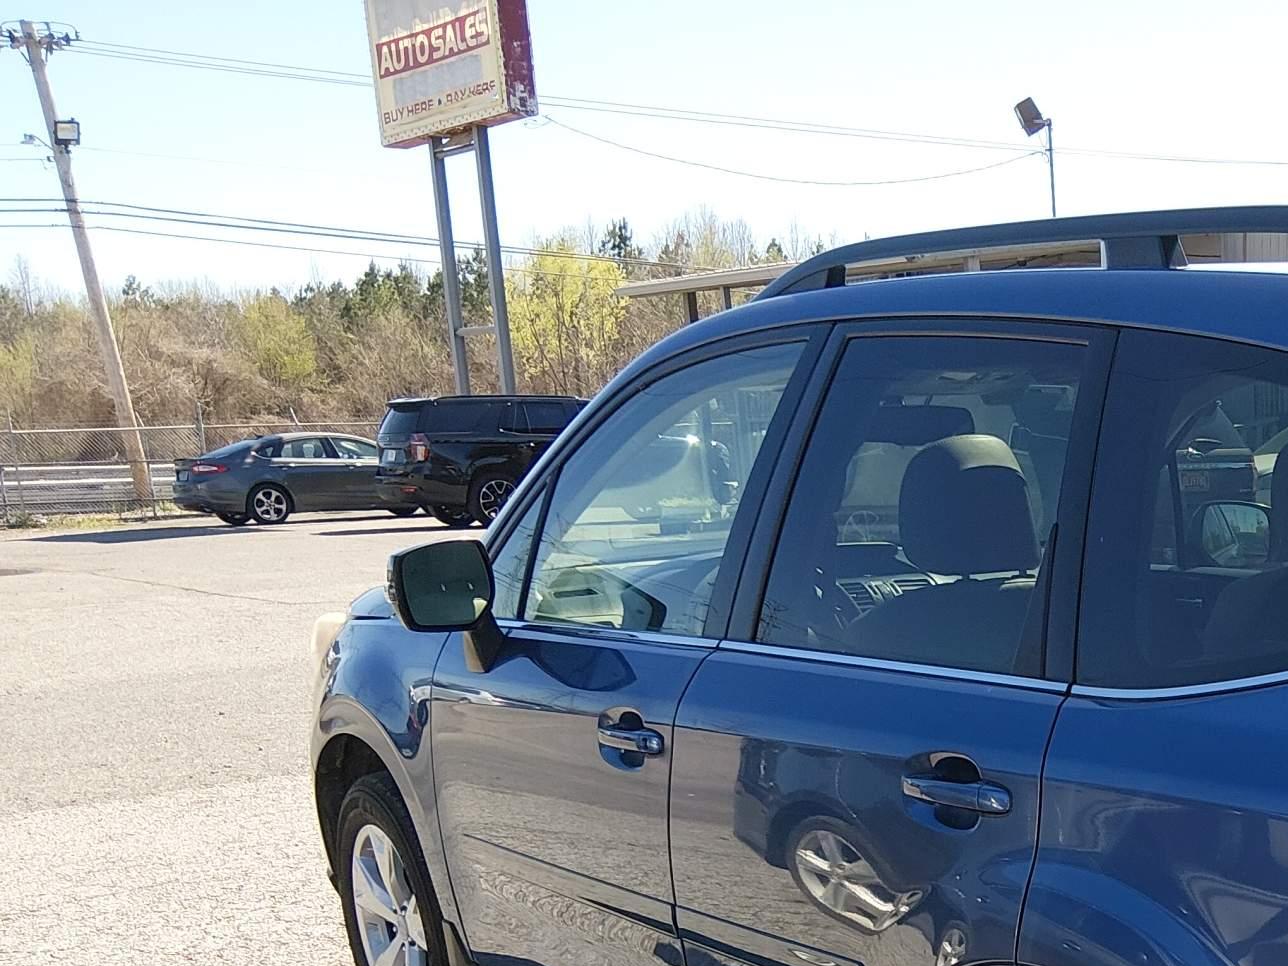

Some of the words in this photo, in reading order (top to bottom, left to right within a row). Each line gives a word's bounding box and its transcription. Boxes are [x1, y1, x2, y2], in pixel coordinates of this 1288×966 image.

[380, 33, 430, 75] AUTO
[430, 13, 489, 60] SALES
[383, 107, 404, 125] BUY
